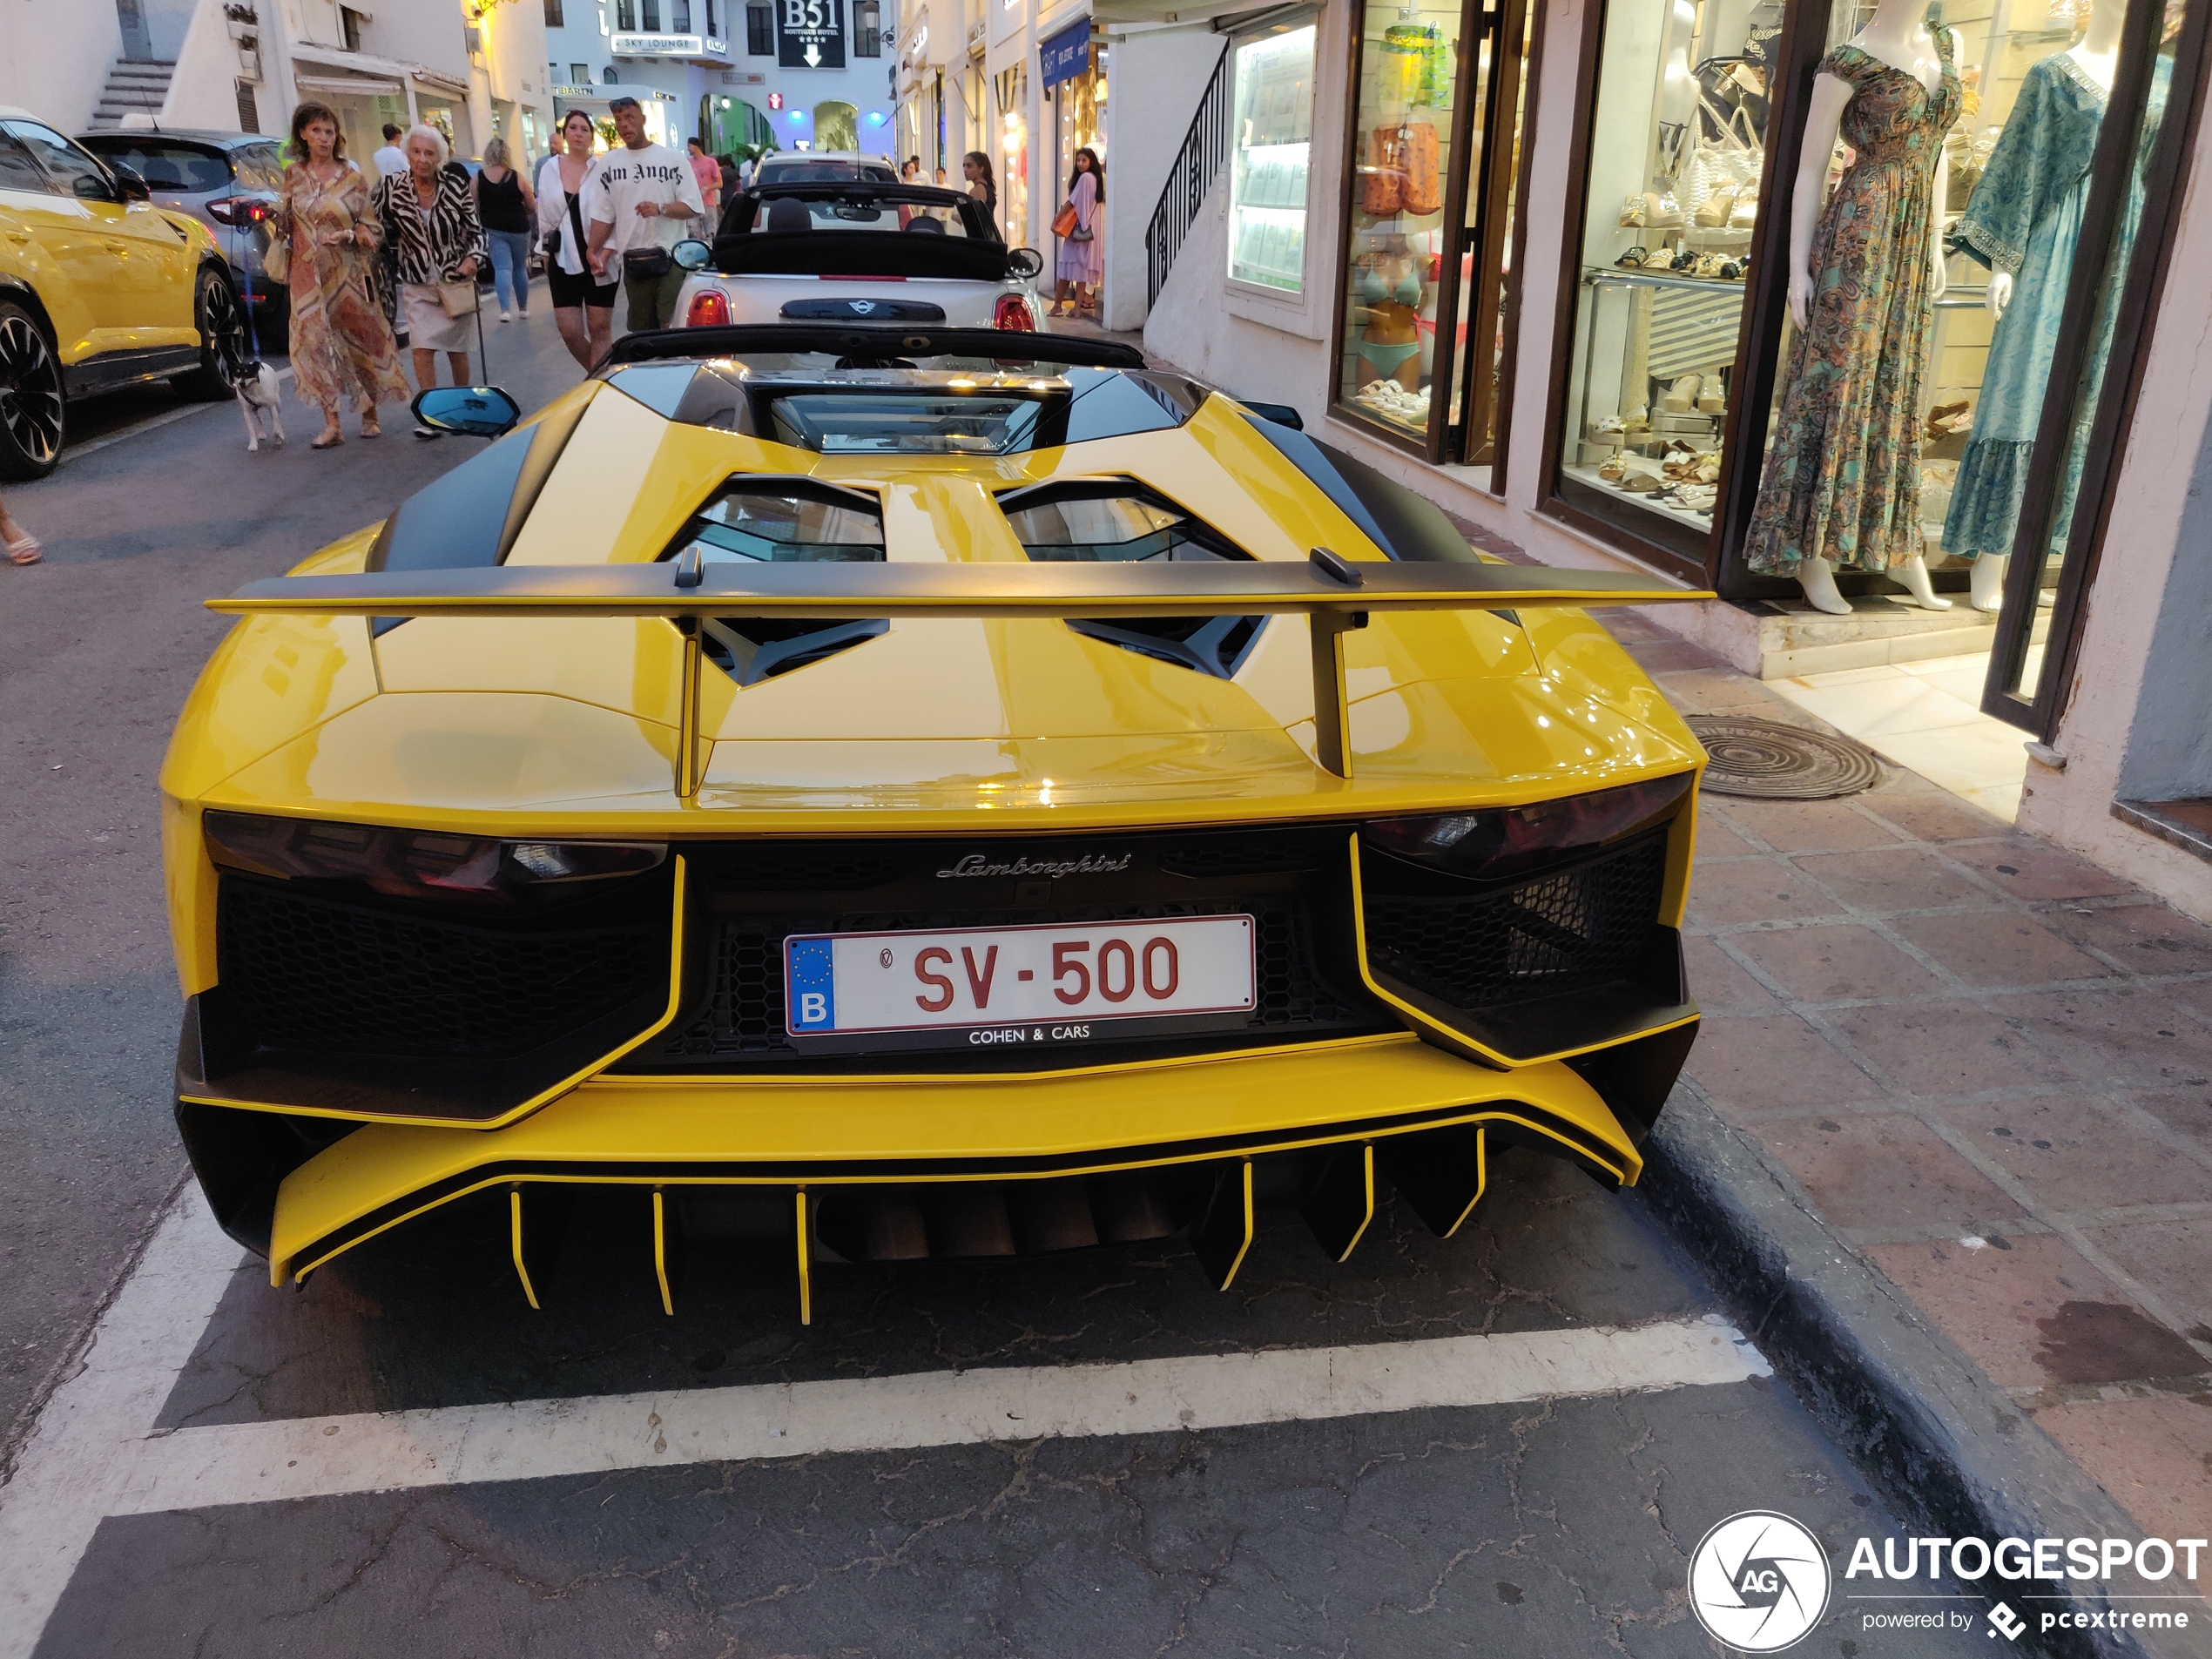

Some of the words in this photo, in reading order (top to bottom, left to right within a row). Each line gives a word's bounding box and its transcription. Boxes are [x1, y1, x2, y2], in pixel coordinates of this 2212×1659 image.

[784, 0, 839, 29] B51
[624, 38, 642, 47] SKY
[648, 39, 689, 48] LOUNGE
[936, 853, 1131, 879] Lamborghini
[801, 993, 827, 1023] B
[969, 1029, 1025, 1044] COHEN
[1033, 1028, 1043, 1041] &
[1051, 1026, 1090, 1040] CARS
